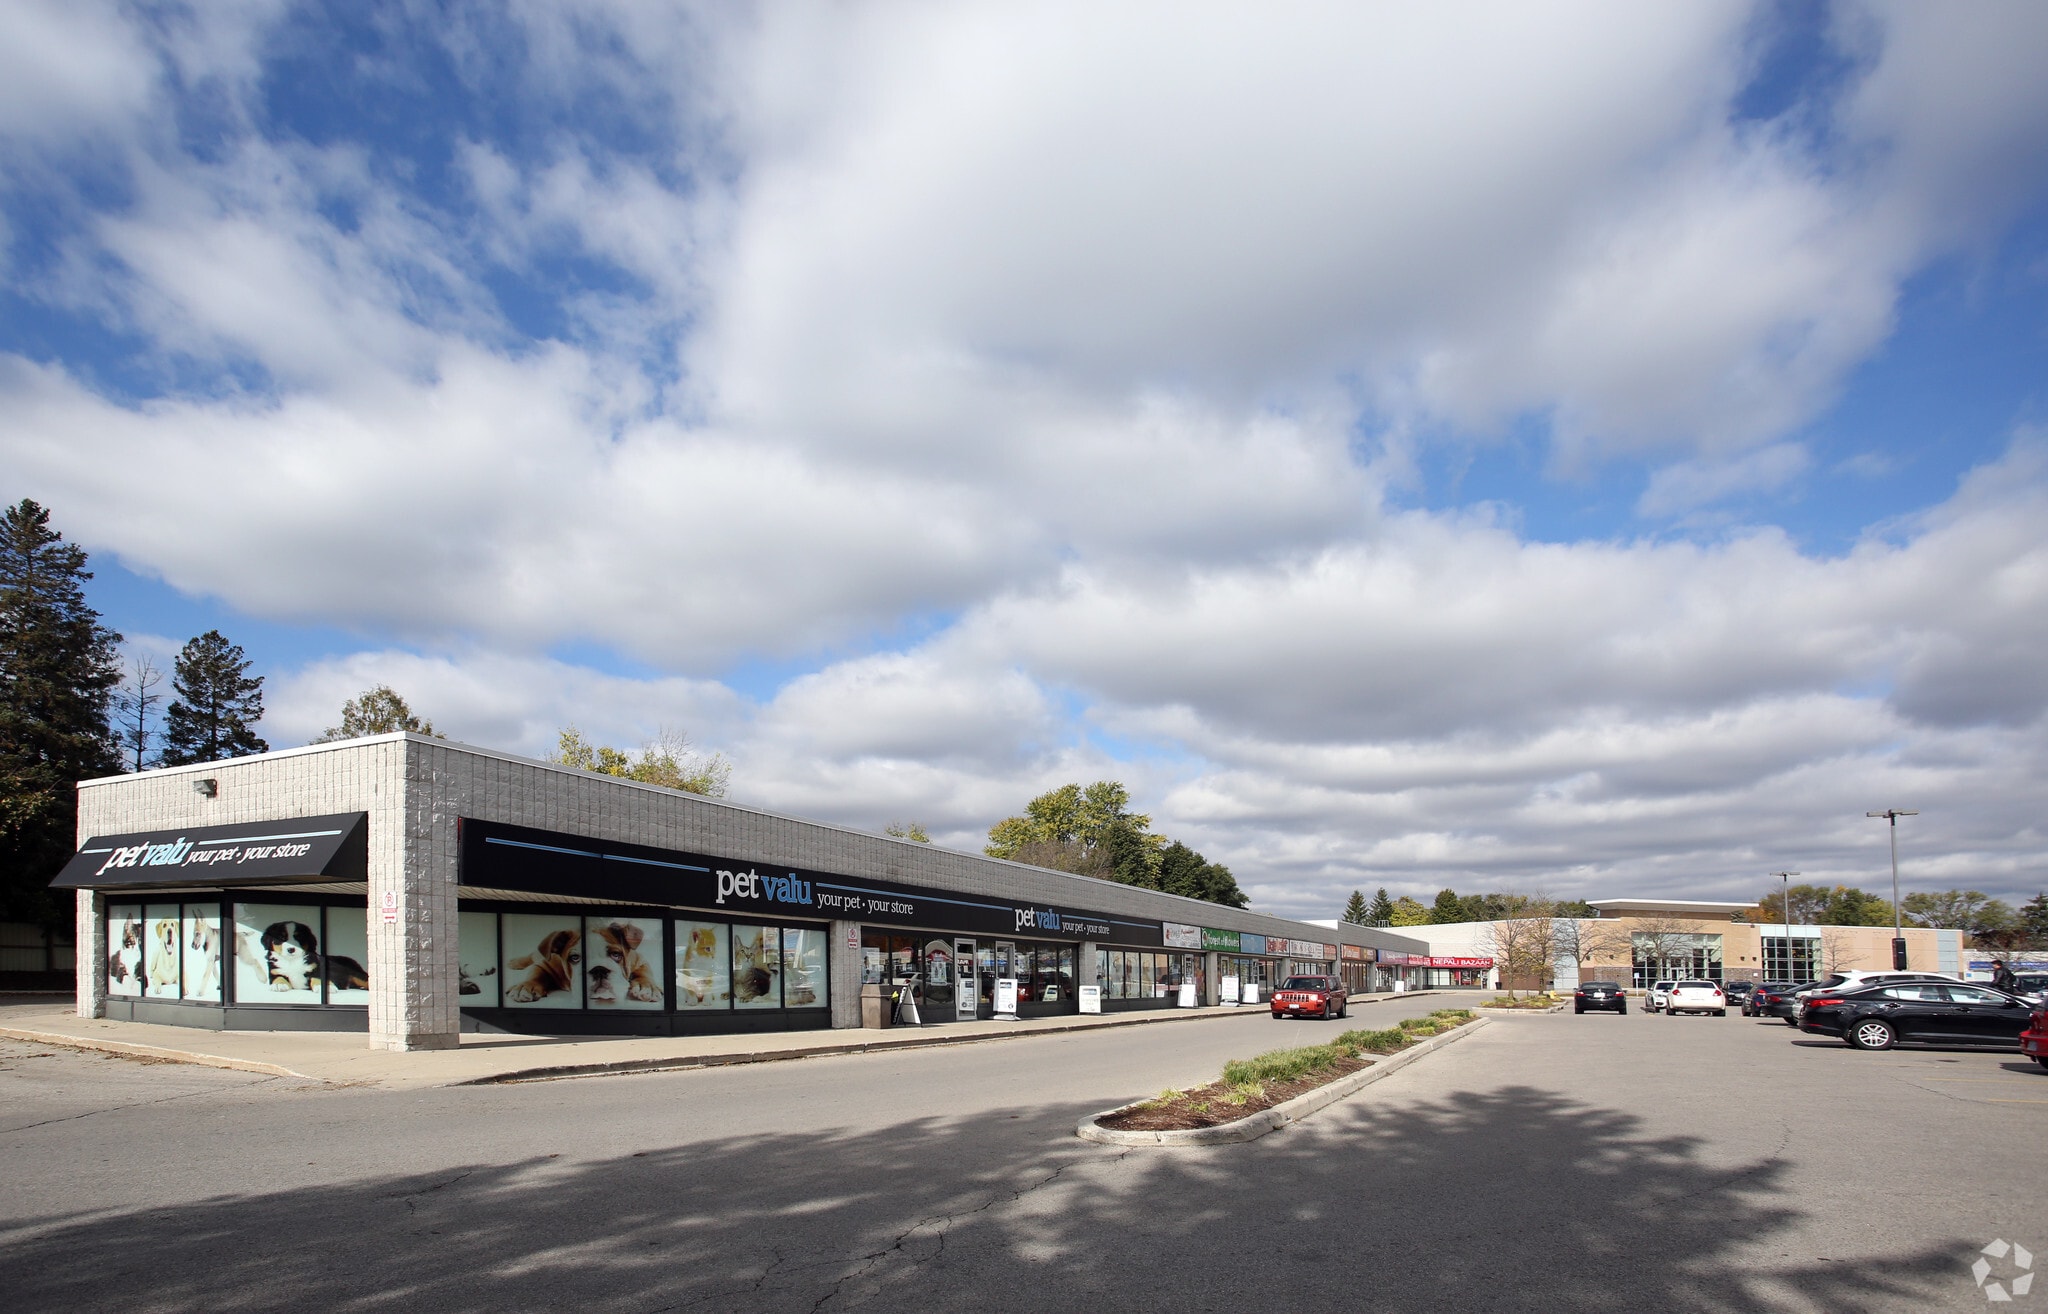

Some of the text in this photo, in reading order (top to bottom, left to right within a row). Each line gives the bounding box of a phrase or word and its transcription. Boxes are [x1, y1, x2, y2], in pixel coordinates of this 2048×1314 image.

[96, 836, 194, 875] pet valu
[181, 842, 311, 867] your pet your store
[716, 869, 812, 904] pet valu
[817, 893, 914, 915] your pet your store
[1015, 907, 1060, 931] pet valu
[1062, 922, 1110, 935] your pet your store
